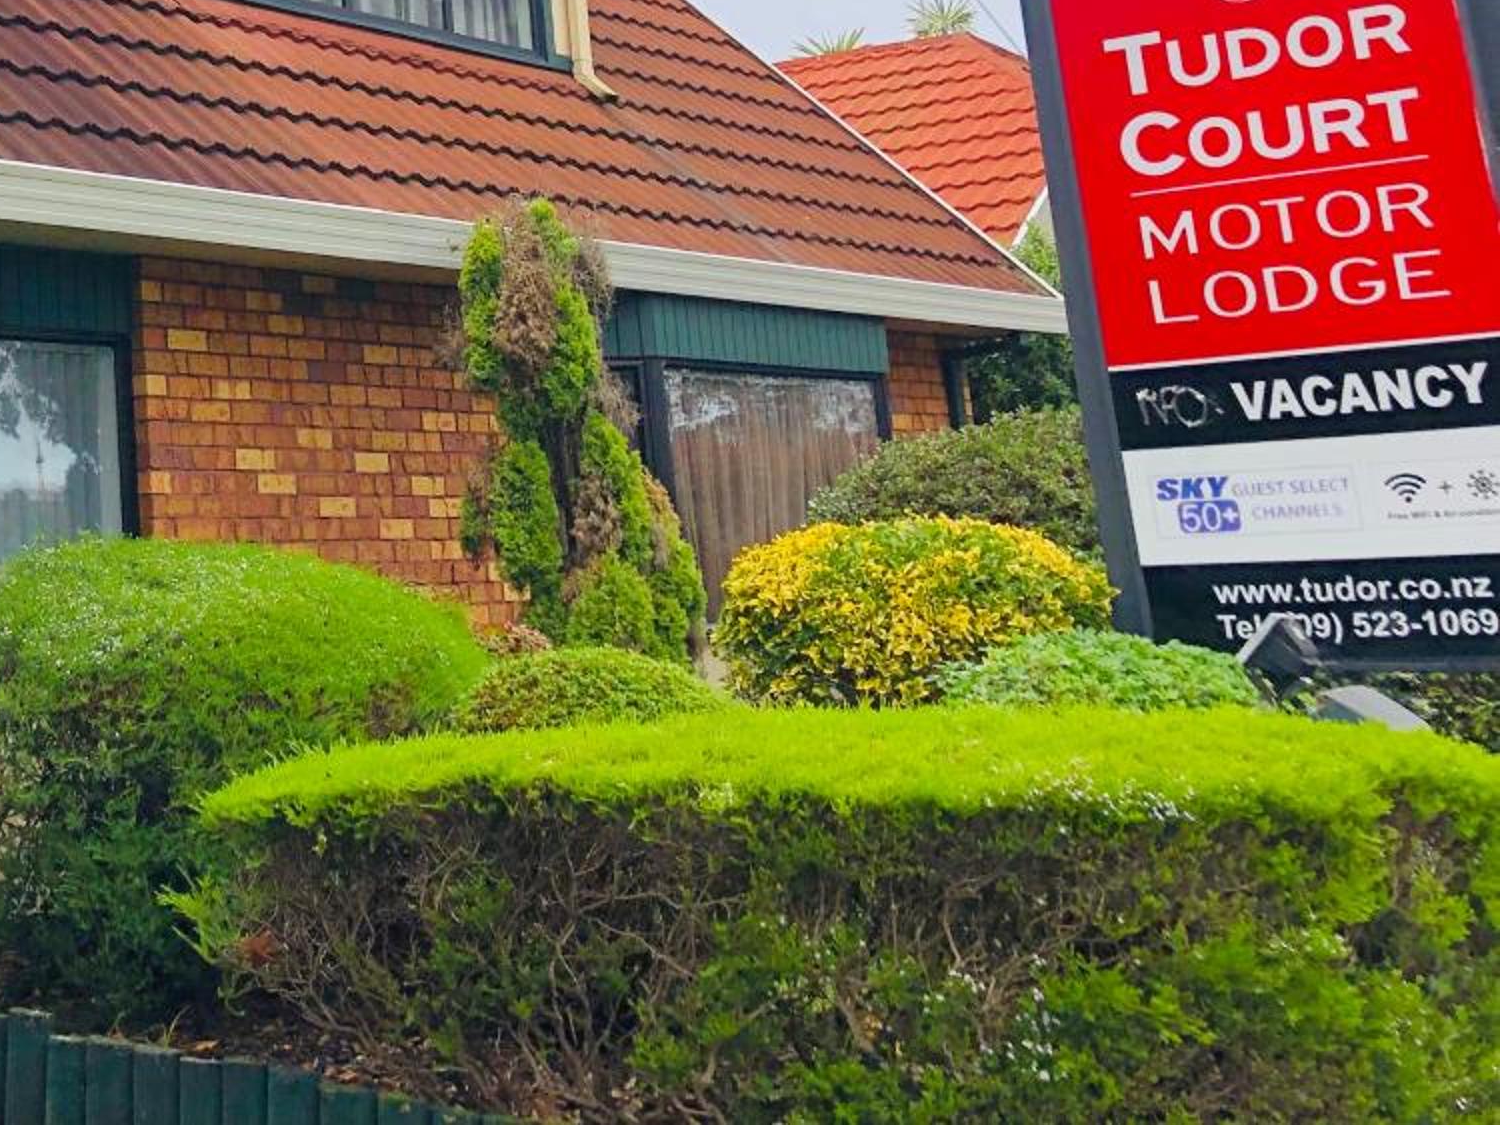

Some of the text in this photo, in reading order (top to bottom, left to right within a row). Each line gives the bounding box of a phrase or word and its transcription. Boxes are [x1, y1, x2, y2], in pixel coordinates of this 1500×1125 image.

[1103, 3, 1412, 96] TUDOR
[1119, 87, 1419, 177] COURT
[1138, 182, 1435, 261] MOTOR
[1148, 249, 1452, 325] LODGE
[1229, 361, 1488, 422] VACANCY
[1156, 476, 1349, 501] SKY GUEST SELECT
[1181, 502, 1343, 532] 50+ CHANNELS
[1212, 575, 1495, 605] www.tudor.co.nz
[1352, 607, 1499, 639] 523-1069
